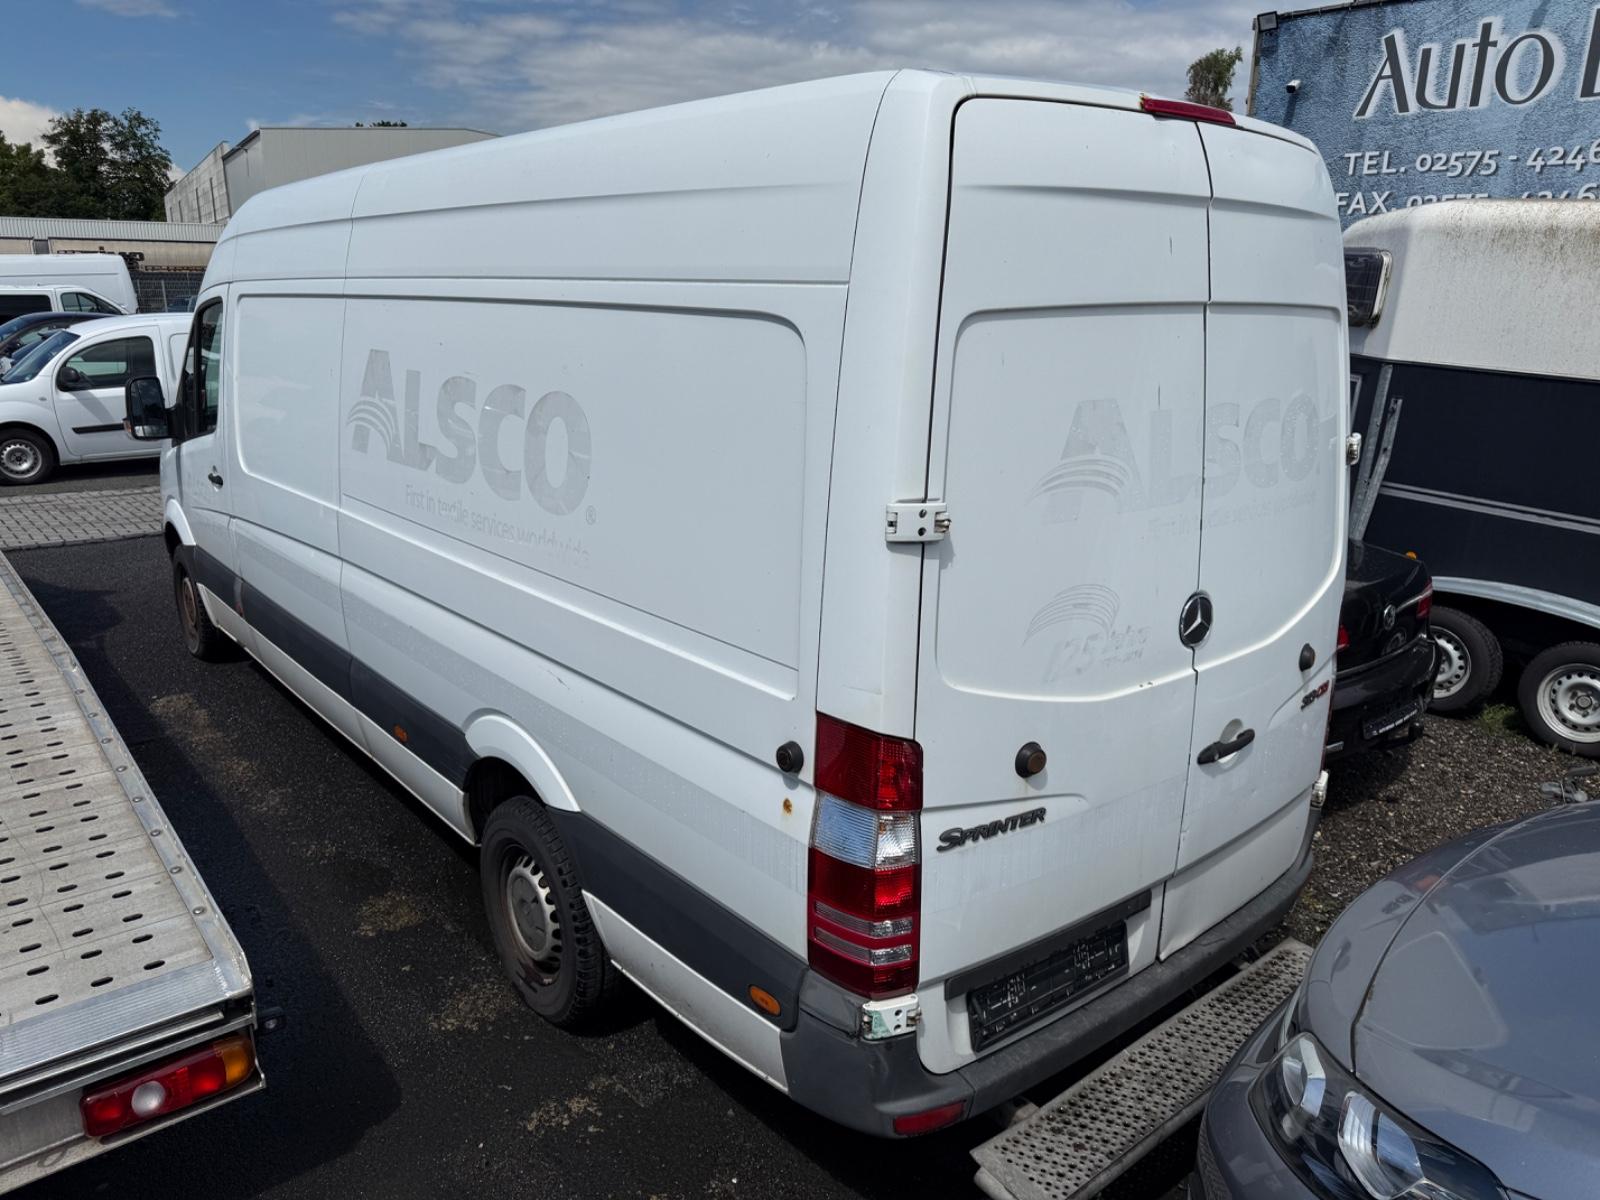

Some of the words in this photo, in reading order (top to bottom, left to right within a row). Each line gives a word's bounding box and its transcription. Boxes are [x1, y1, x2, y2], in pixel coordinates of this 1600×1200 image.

[1354, 20, 1557, 118] Auto
[1344, 150, 1406, 175] TEL.
[1415, 150, 1499, 177] 02575
[346, 348, 592, 516] ALSCO
